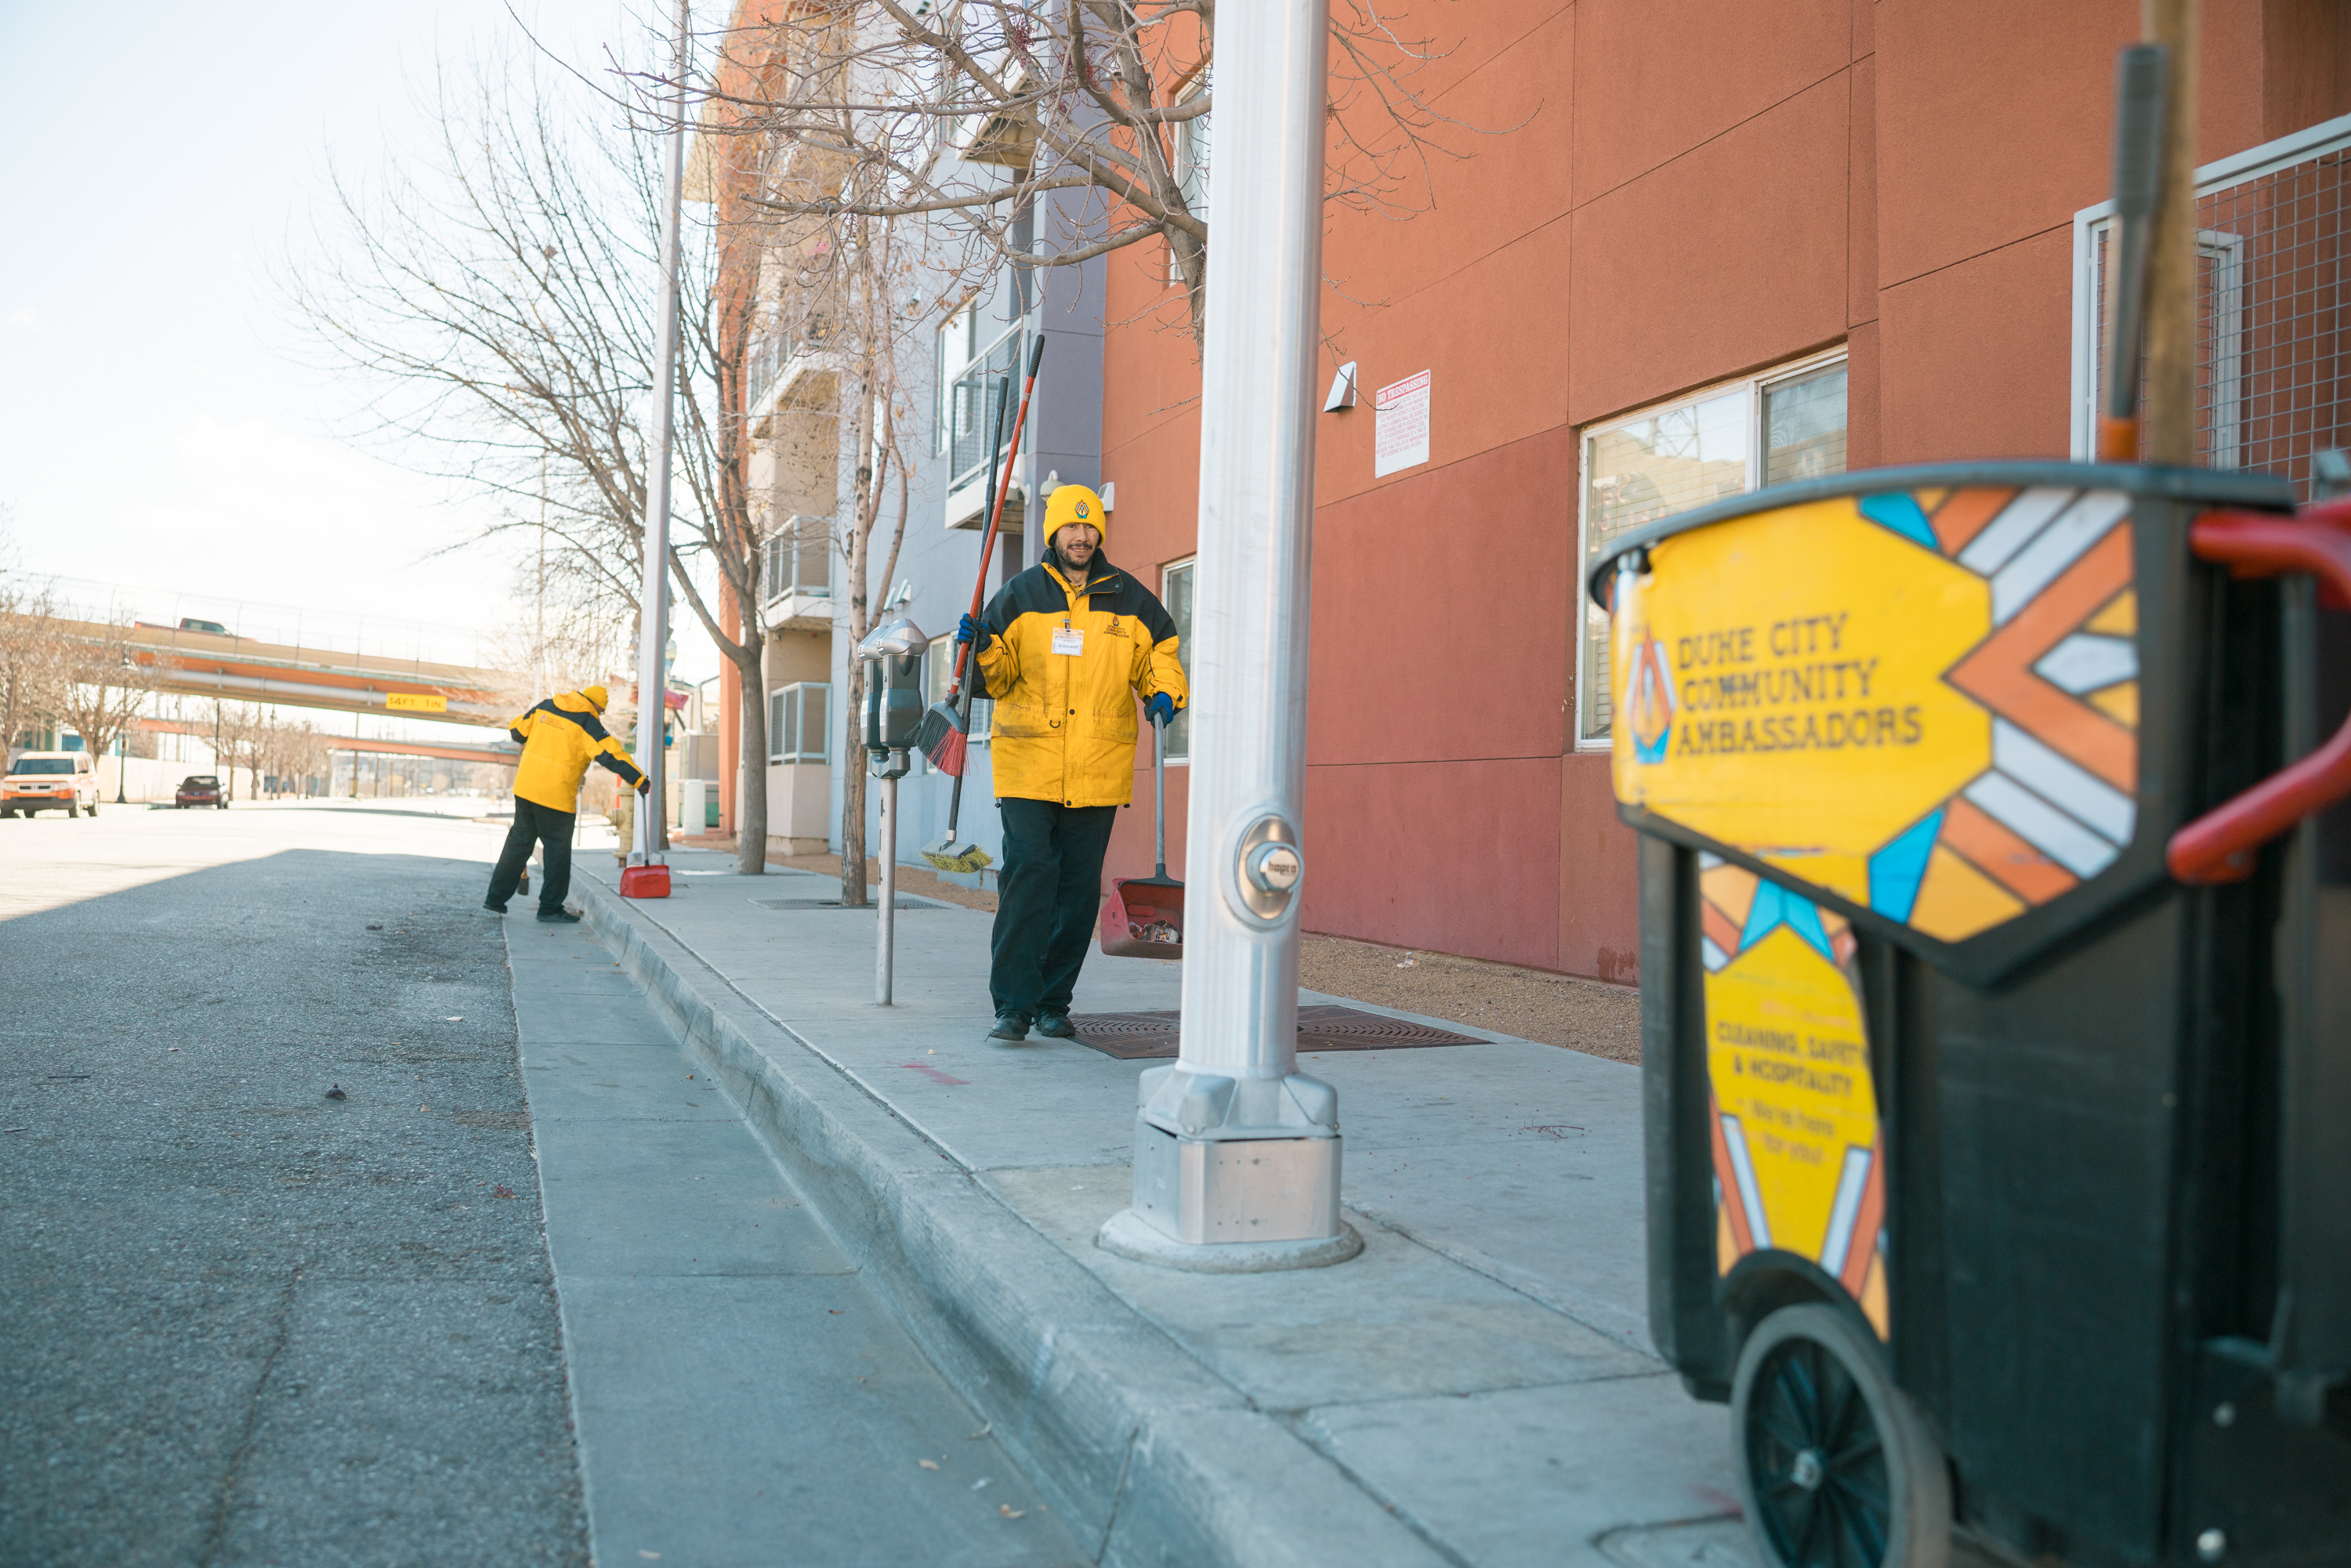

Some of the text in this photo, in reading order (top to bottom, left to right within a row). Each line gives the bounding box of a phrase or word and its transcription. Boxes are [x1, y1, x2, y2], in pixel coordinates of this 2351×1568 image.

[1378, 375, 1428, 404] NO TRESPASSING
[1679, 610, 1849, 671] DUKE CITY
[1681, 657, 1879, 713] COMMUNITY
[1675, 705, 1925, 756] AMBASSADORS
[1749, 1058, 1854, 1099] HOSPITALITY
